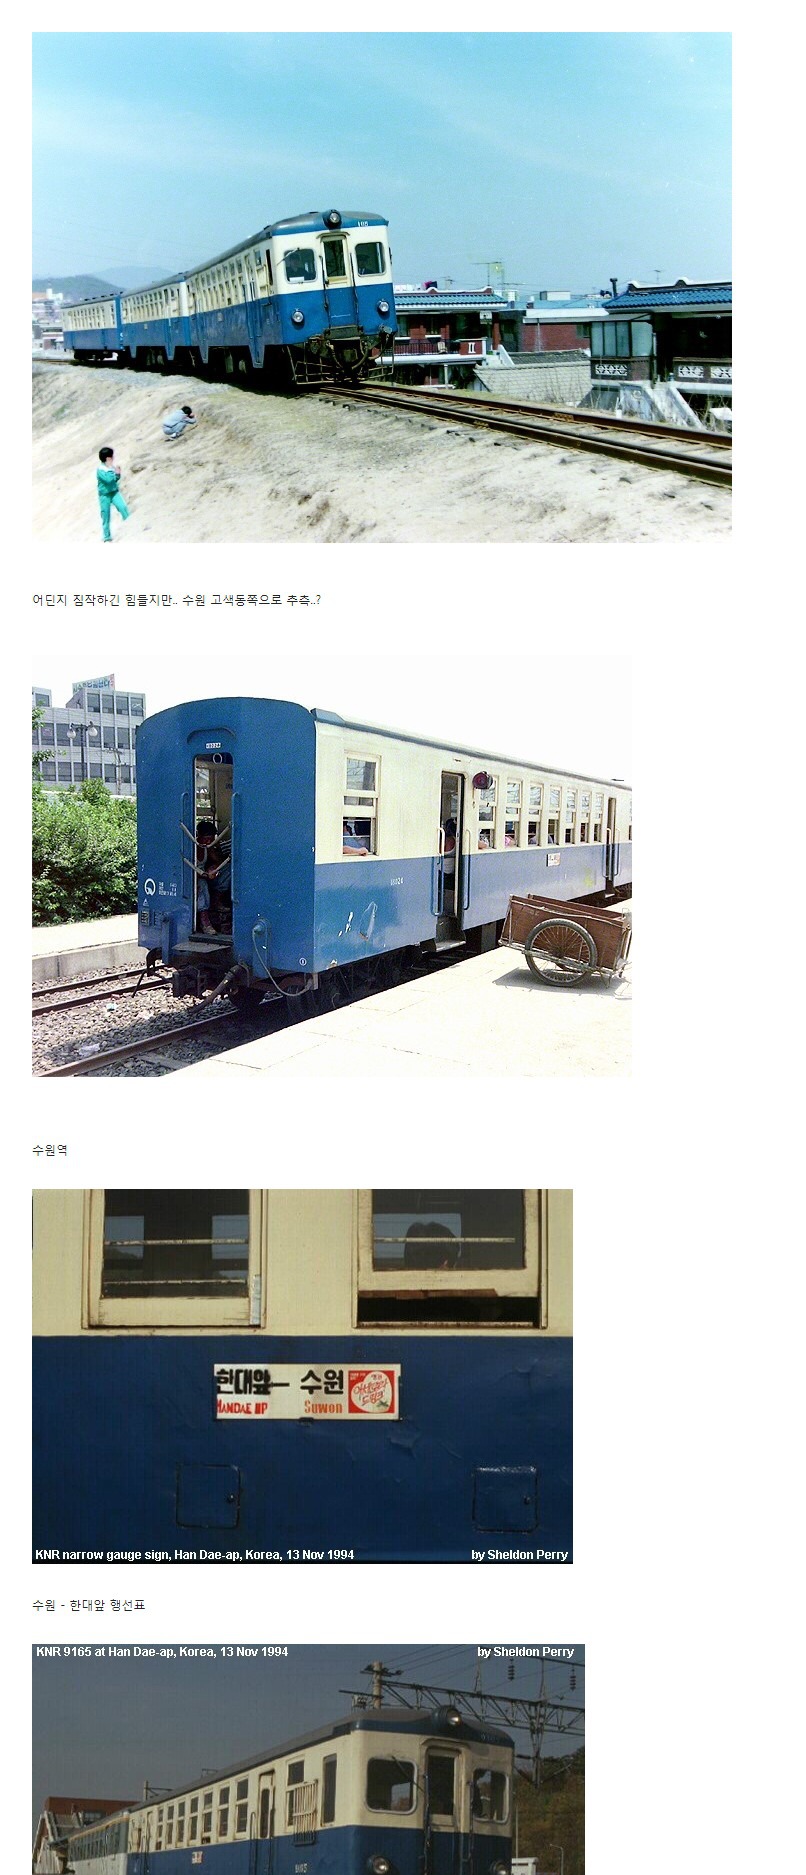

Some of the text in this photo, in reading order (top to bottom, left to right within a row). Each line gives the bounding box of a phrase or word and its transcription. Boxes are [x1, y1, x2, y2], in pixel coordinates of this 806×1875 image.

[216, 1369, 344, 1395] 한대앞 수원
[304, 1400, 343, 1414] Suwon
